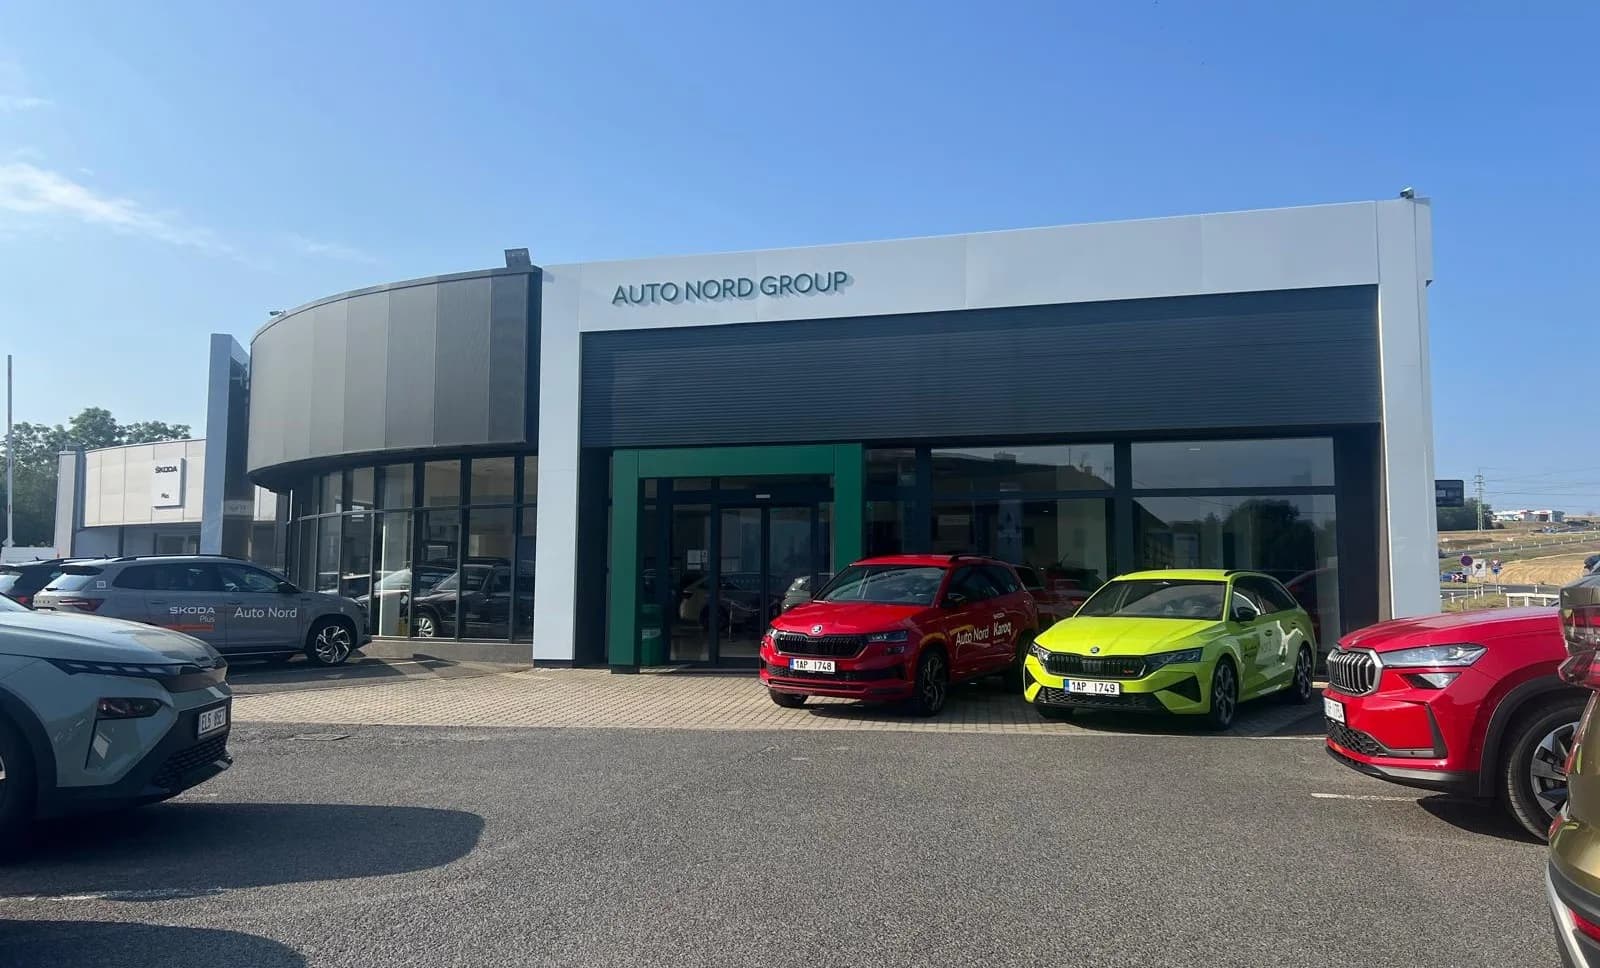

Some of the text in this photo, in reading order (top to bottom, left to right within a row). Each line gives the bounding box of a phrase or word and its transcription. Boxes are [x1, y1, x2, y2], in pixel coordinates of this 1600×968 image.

[611, 271, 848, 305] AUTO NORD GROUP
[199, 614, 216, 623] Plus
[233, 607, 298, 618] Auto Nord
[993, 621, 1012, 637] Karoq
[956, 625, 990, 647] Auto Nord
[1072, 681, 1087, 691] 1AP
